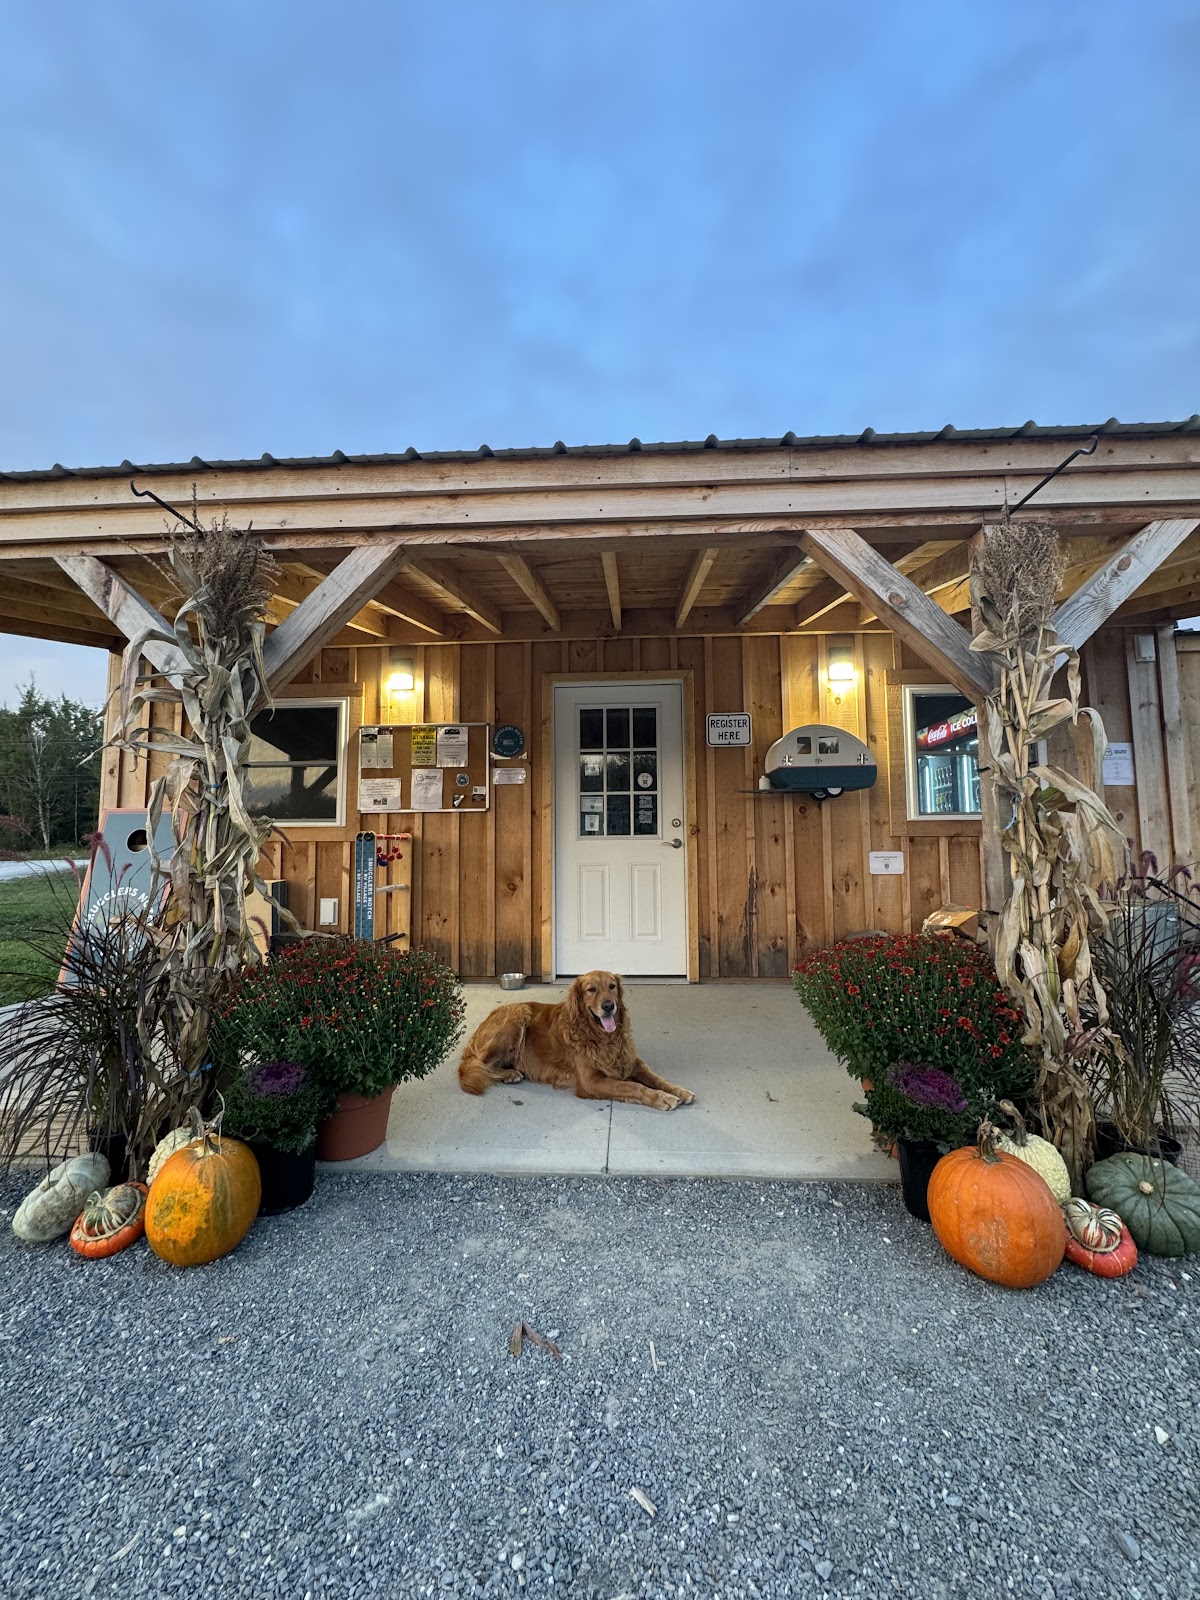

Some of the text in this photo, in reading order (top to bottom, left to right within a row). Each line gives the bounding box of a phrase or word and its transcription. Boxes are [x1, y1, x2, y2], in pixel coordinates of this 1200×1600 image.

[710, 719, 748, 728] REGISTER
[950, 721, 962, 733] ICE
[718, 731, 741, 740] HERE
